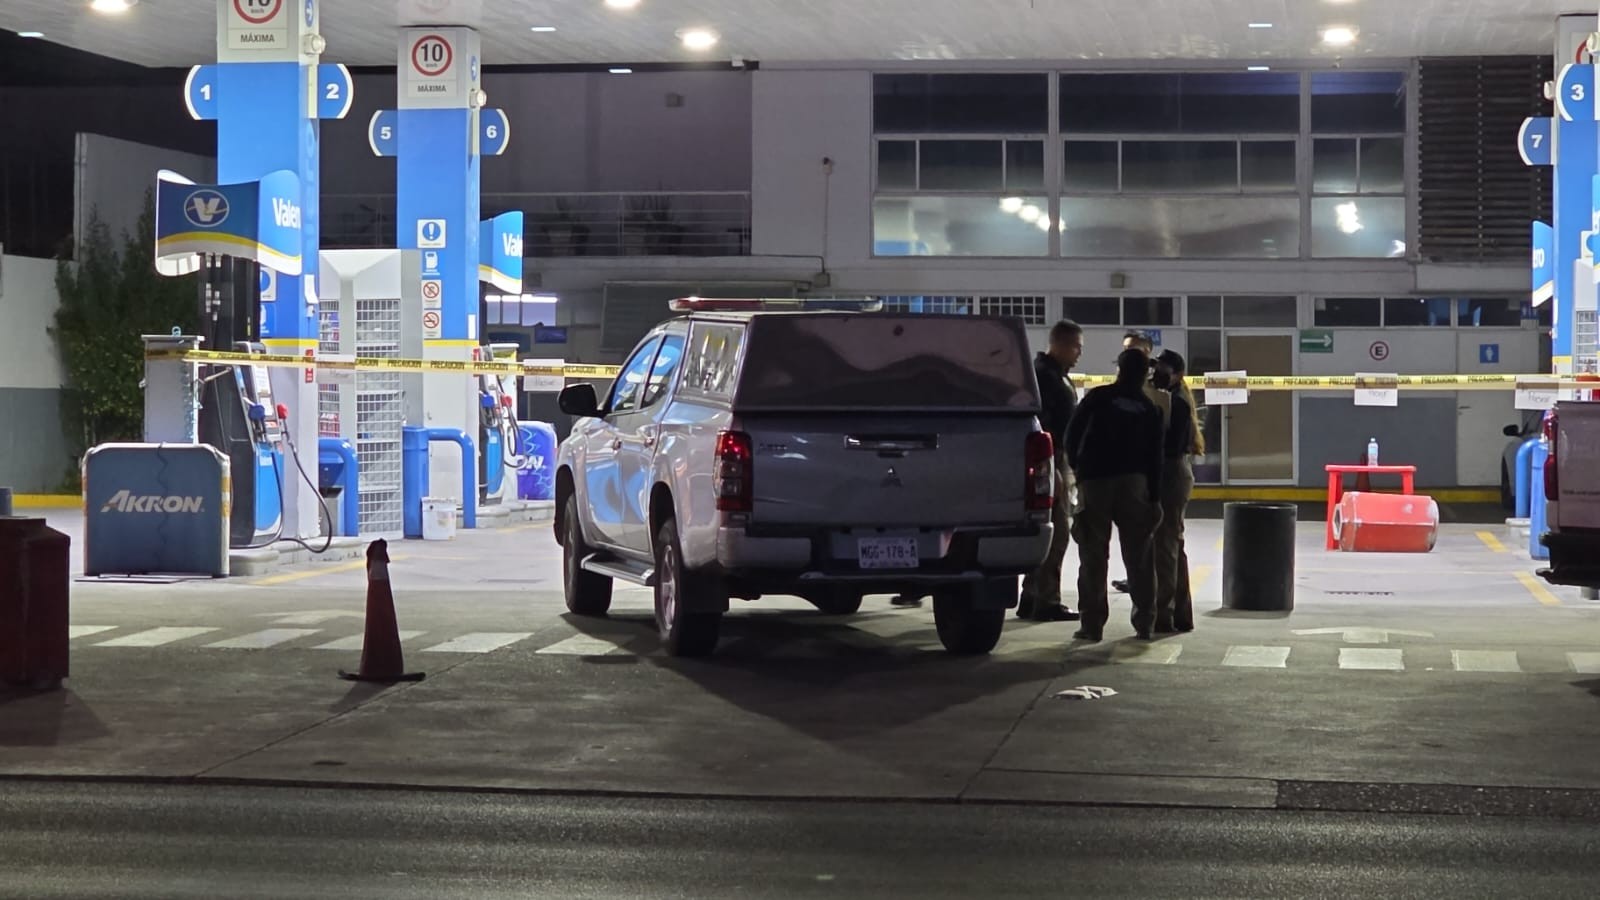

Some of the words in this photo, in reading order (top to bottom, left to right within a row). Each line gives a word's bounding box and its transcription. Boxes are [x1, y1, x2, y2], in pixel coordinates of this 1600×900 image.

[421, 43, 443, 62] 10
[200, 84, 211, 101] 1
[326, 83, 340, 99] 2
[1571, 84, 1585, 100] 3
[380, 126, 392, 139] 5
[486, 125, 498, 139] 6
[1531, 134, 1543, 148] 7
[1375, 346, 1383, 356] E
[101, 489, 203, 513] AKRON
